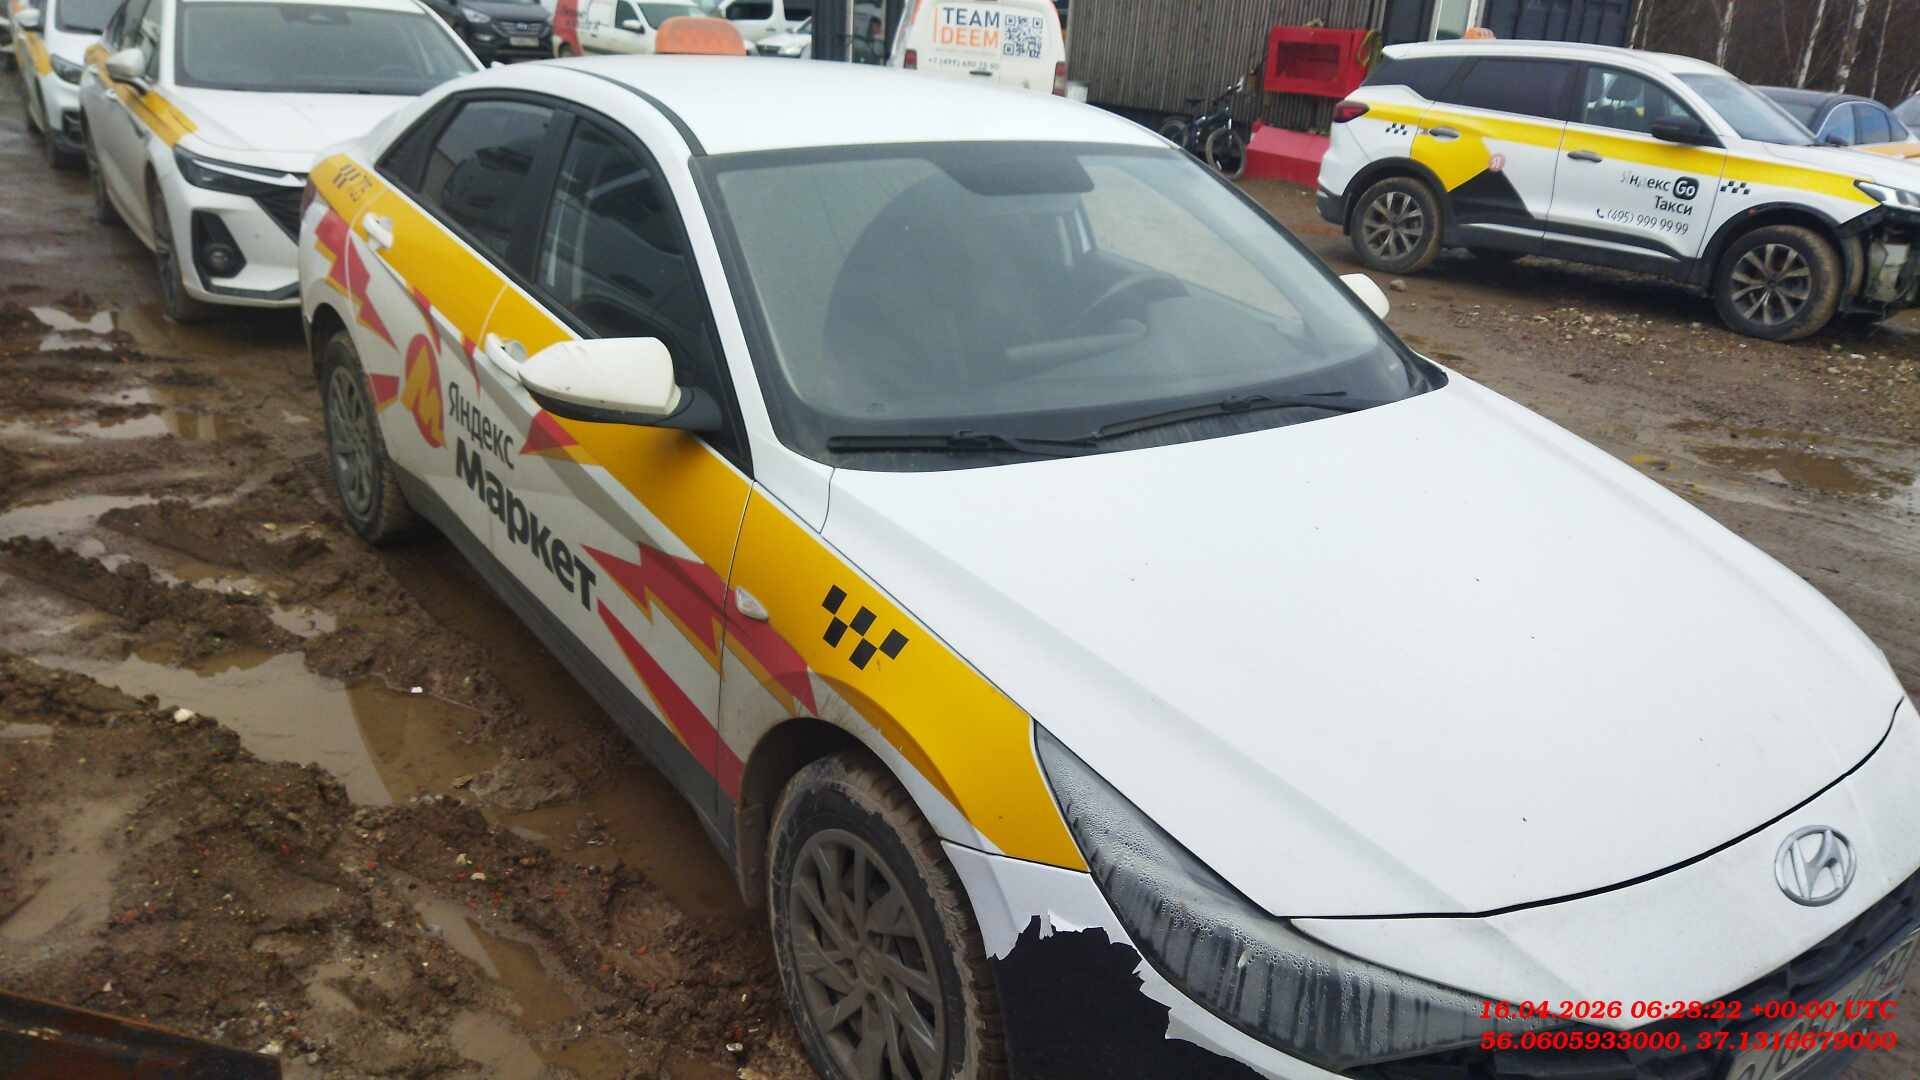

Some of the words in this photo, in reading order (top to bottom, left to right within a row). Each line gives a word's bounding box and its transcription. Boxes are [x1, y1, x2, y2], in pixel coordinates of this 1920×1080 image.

[943, 8, 1000, 28] TEAM
[940, 27, 998, 48] DEEM
[1675, 180, 1697, 196] Go
[1655, 195, 1693, 216] Такси
[1607, 208, 1634, 223] (495)
[1637, 214, 1658, 228] 999
[1660, 218, 1674, 231] 99
[1675, 222, 1689, 236] 99
[448, 381, 515, 470] Яндекс
[456, 437, 597, 612] Маркет
